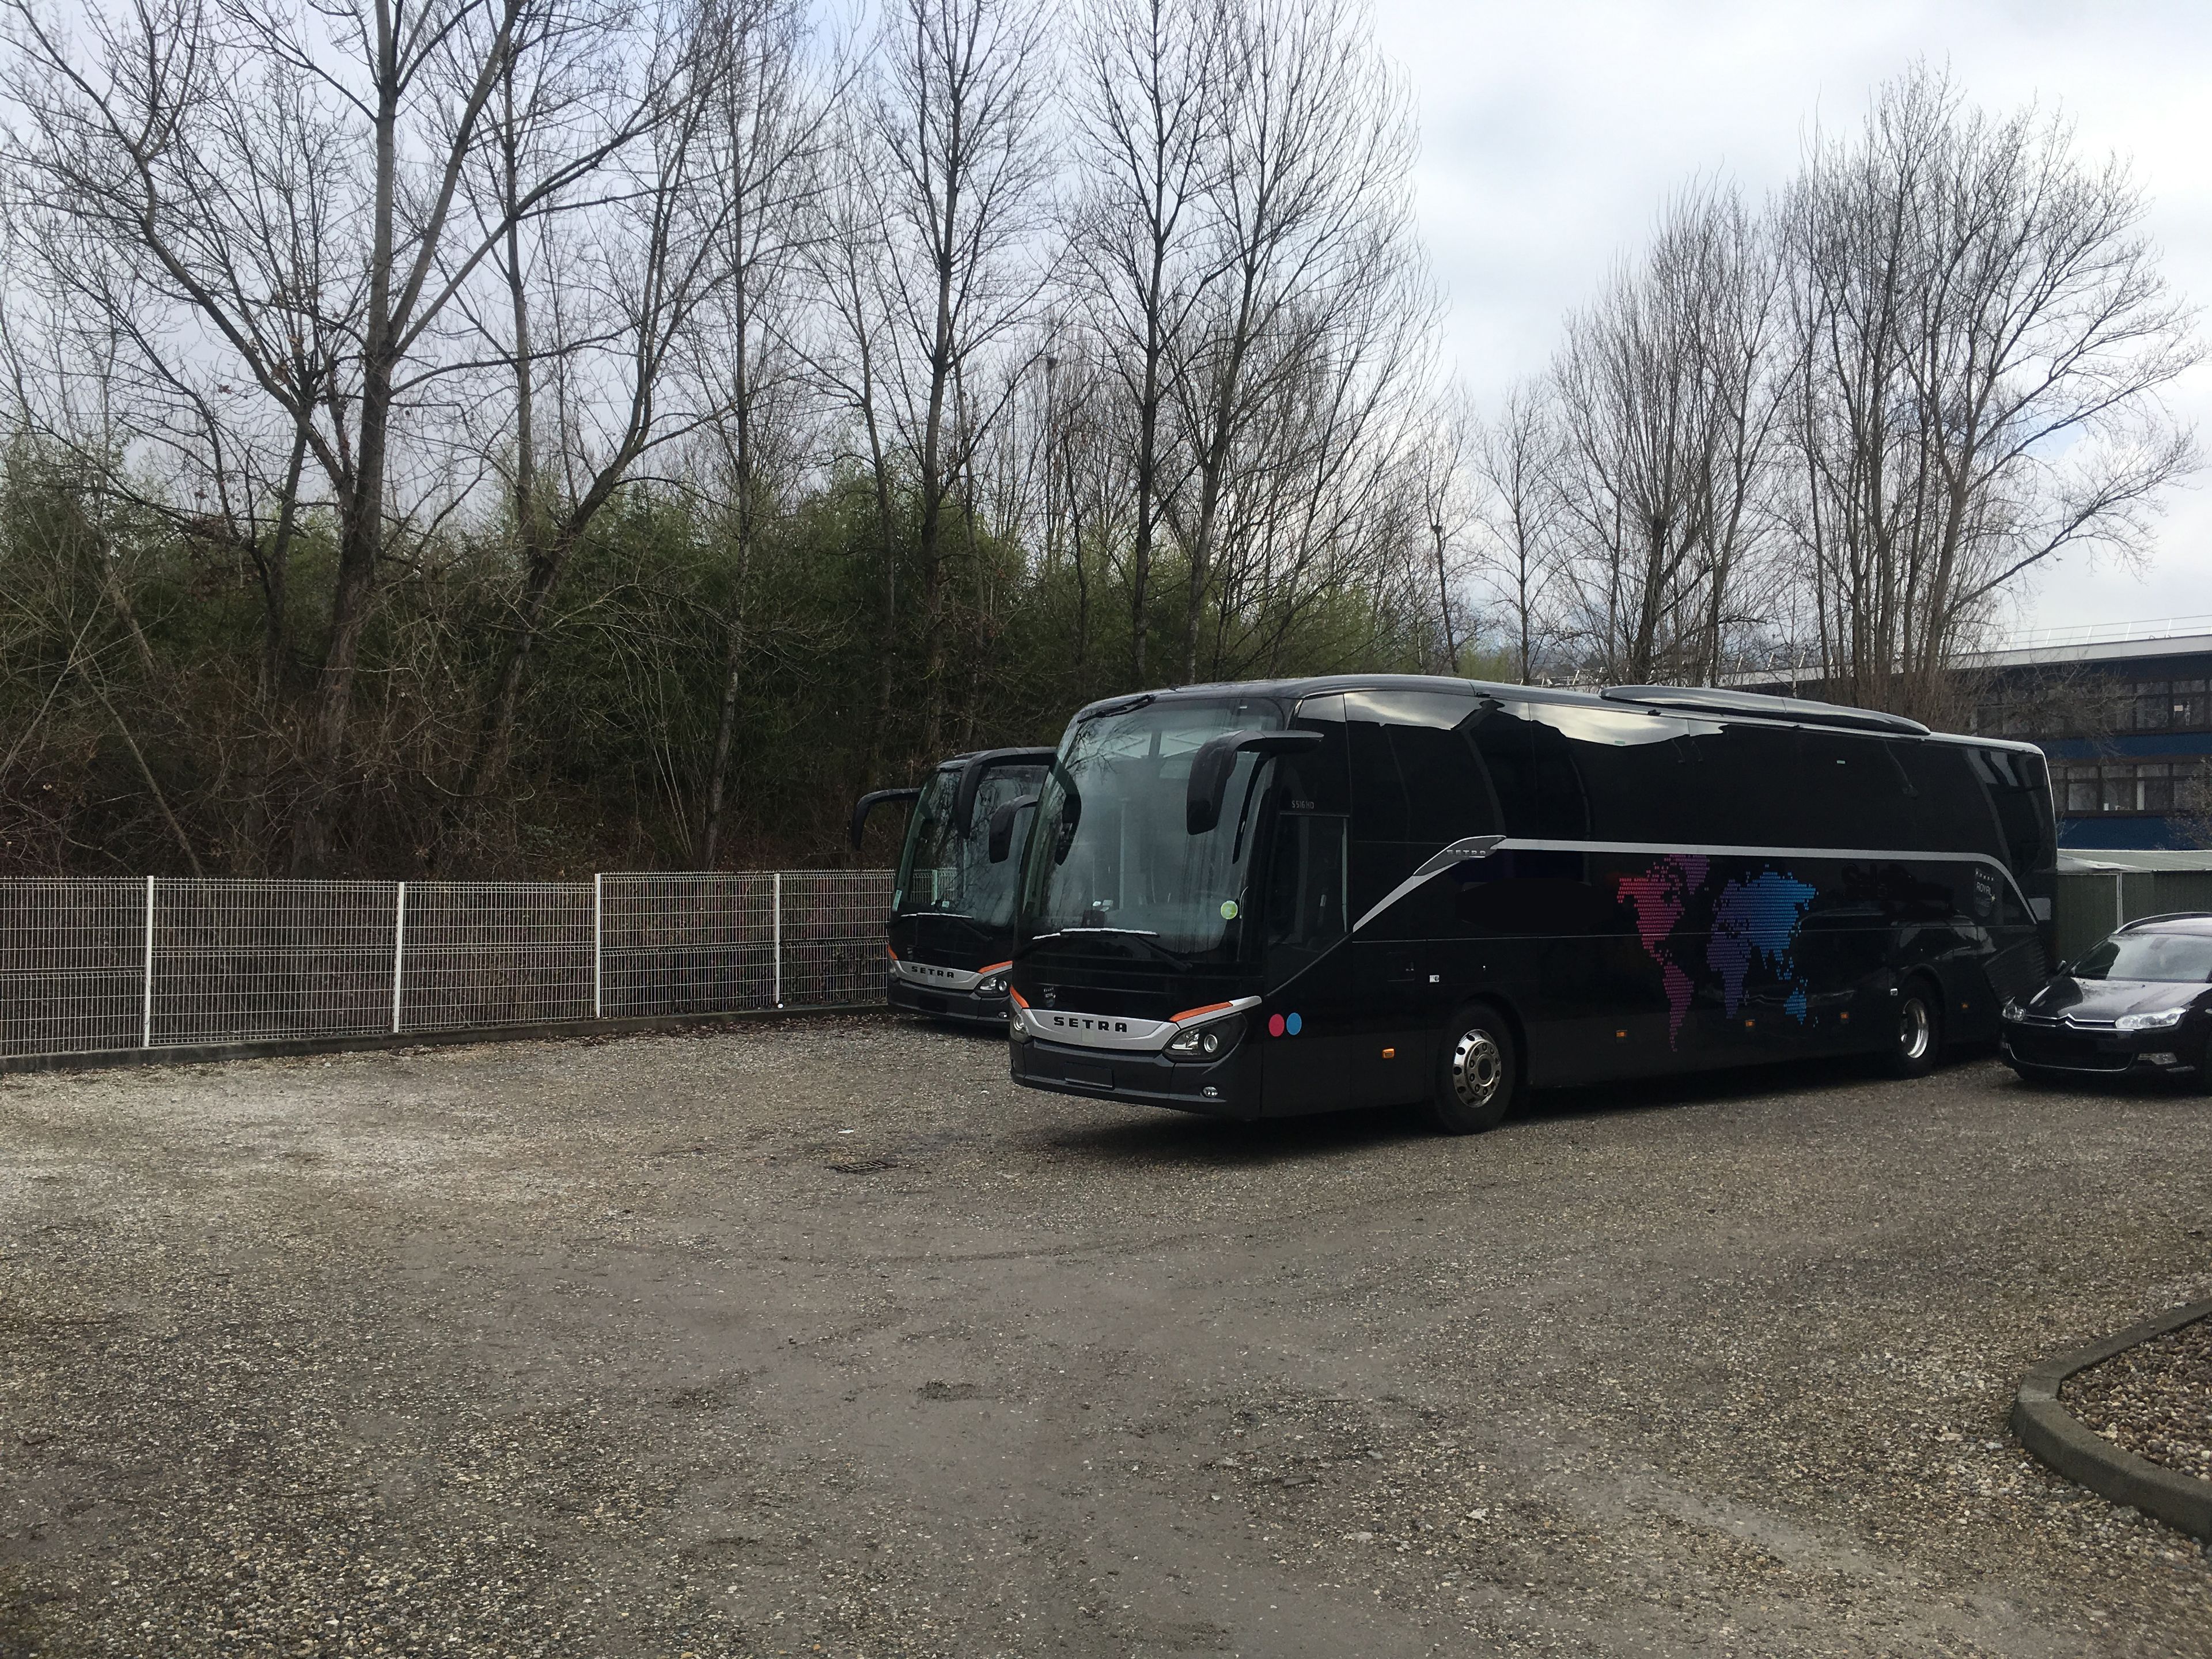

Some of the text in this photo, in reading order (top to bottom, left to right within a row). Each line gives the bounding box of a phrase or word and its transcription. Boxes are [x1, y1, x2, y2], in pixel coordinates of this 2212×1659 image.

[1976, 881, 1992, 896] ROYAL
[911, 965, 955, 978] SETRA
[1053, 1016, 1127, 1033] SETRA
